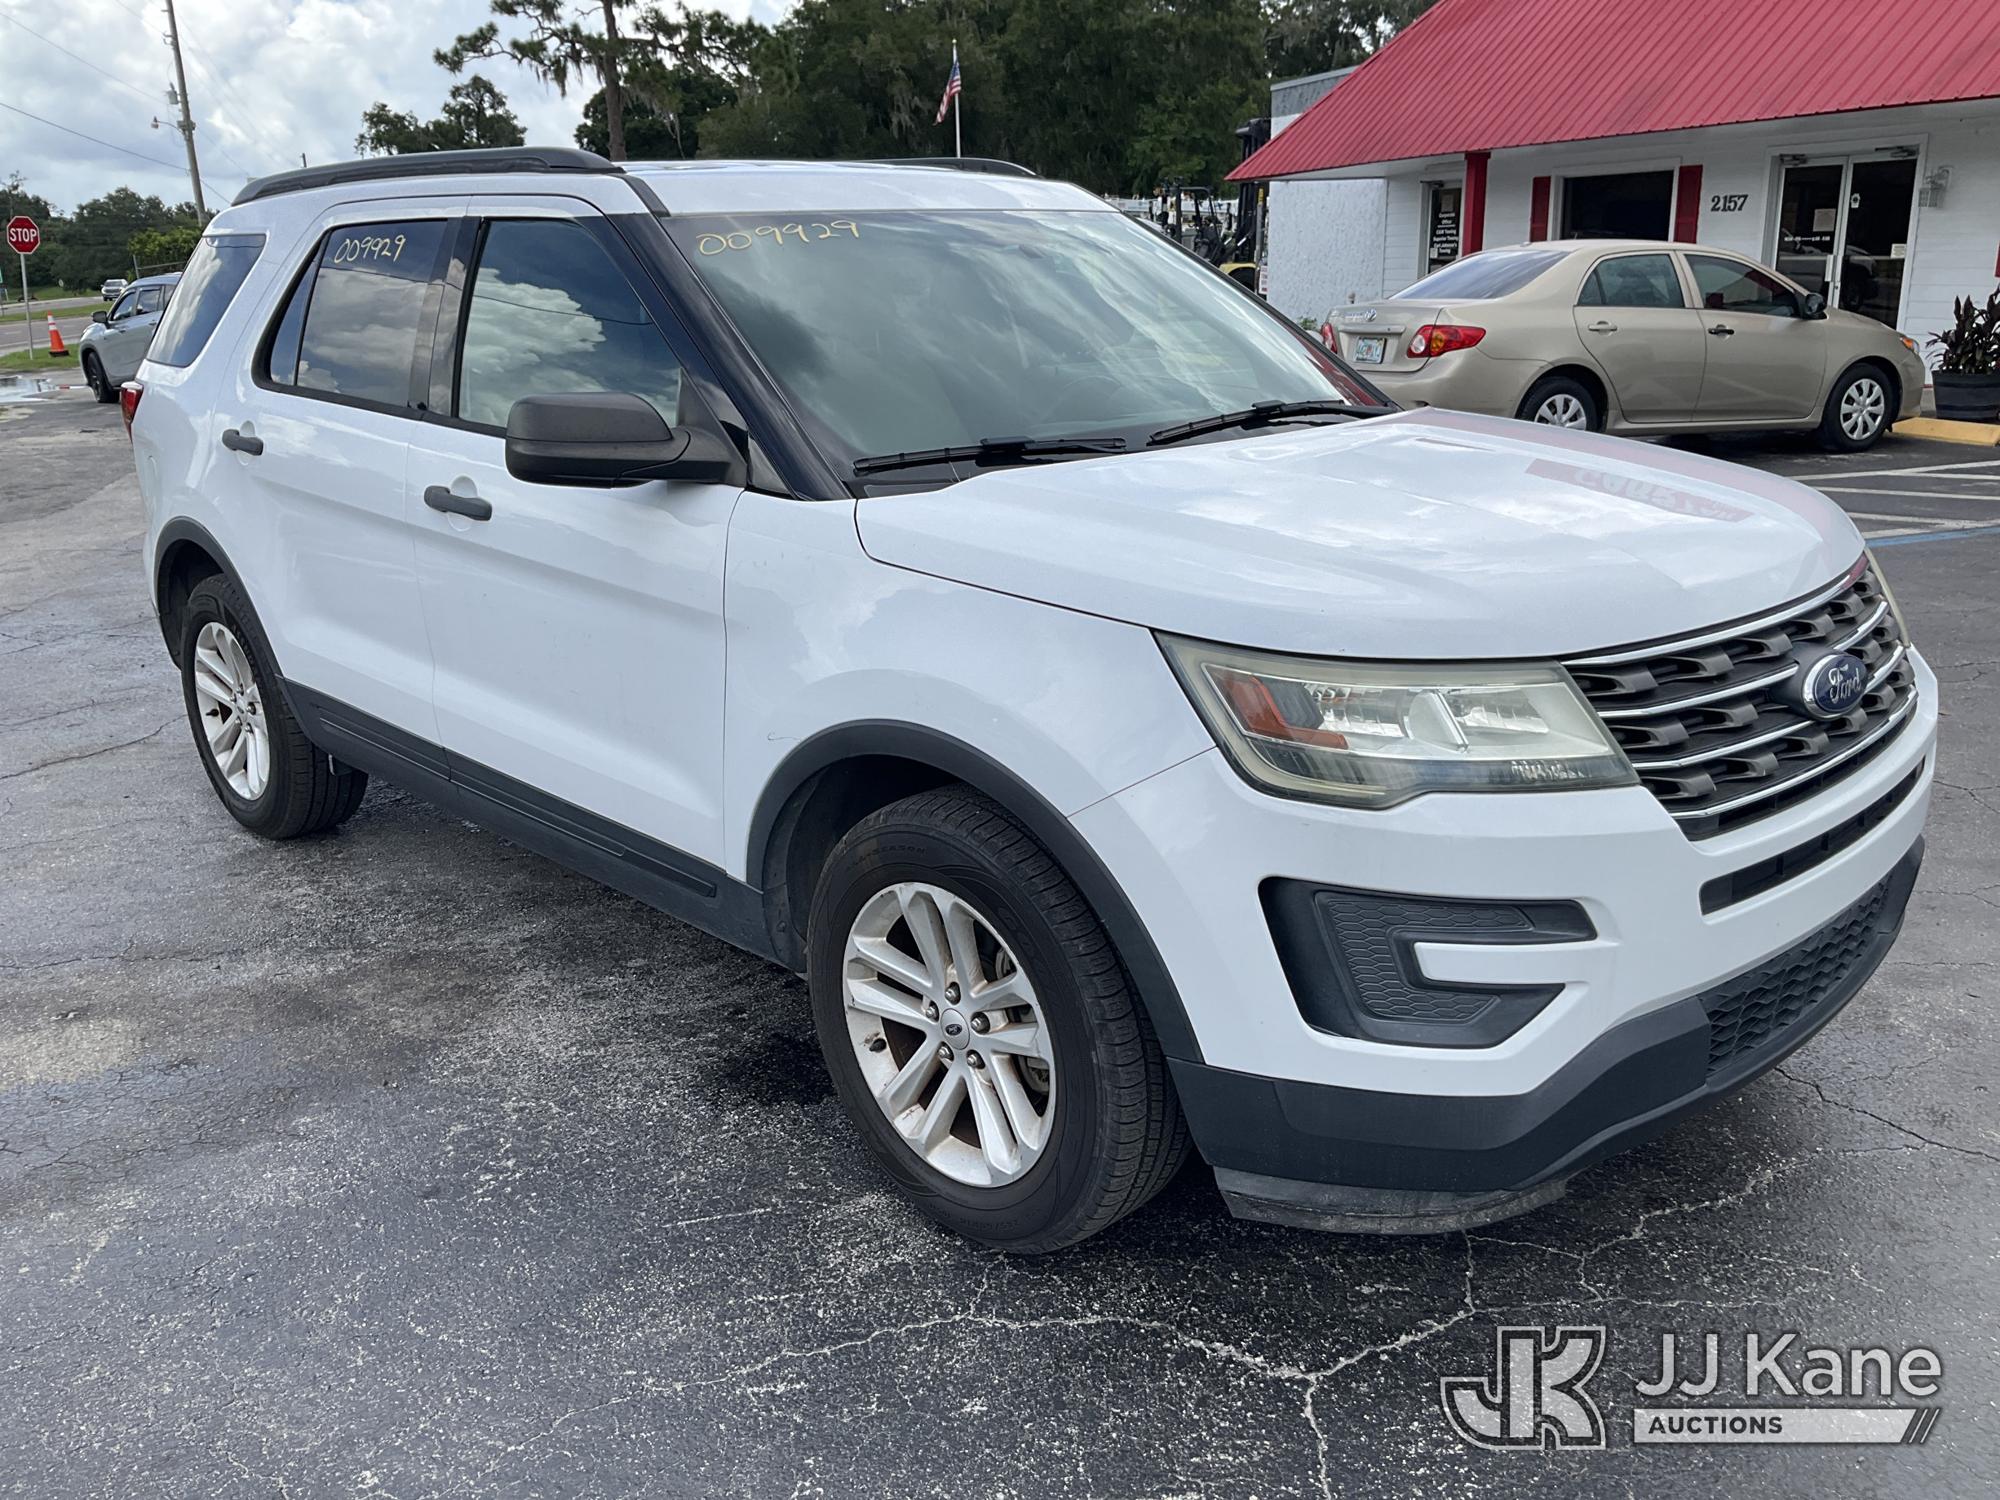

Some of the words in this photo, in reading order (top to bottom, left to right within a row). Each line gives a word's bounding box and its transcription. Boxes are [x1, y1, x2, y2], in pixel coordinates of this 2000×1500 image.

[1710, 193, 1749, 212] 2157
[9, 227, 37, 242] STOP
[334, 234, 408, 264] 009929
[698, 219, 861, 257] 009929
[1828, 663, 1862, 704] Ford
